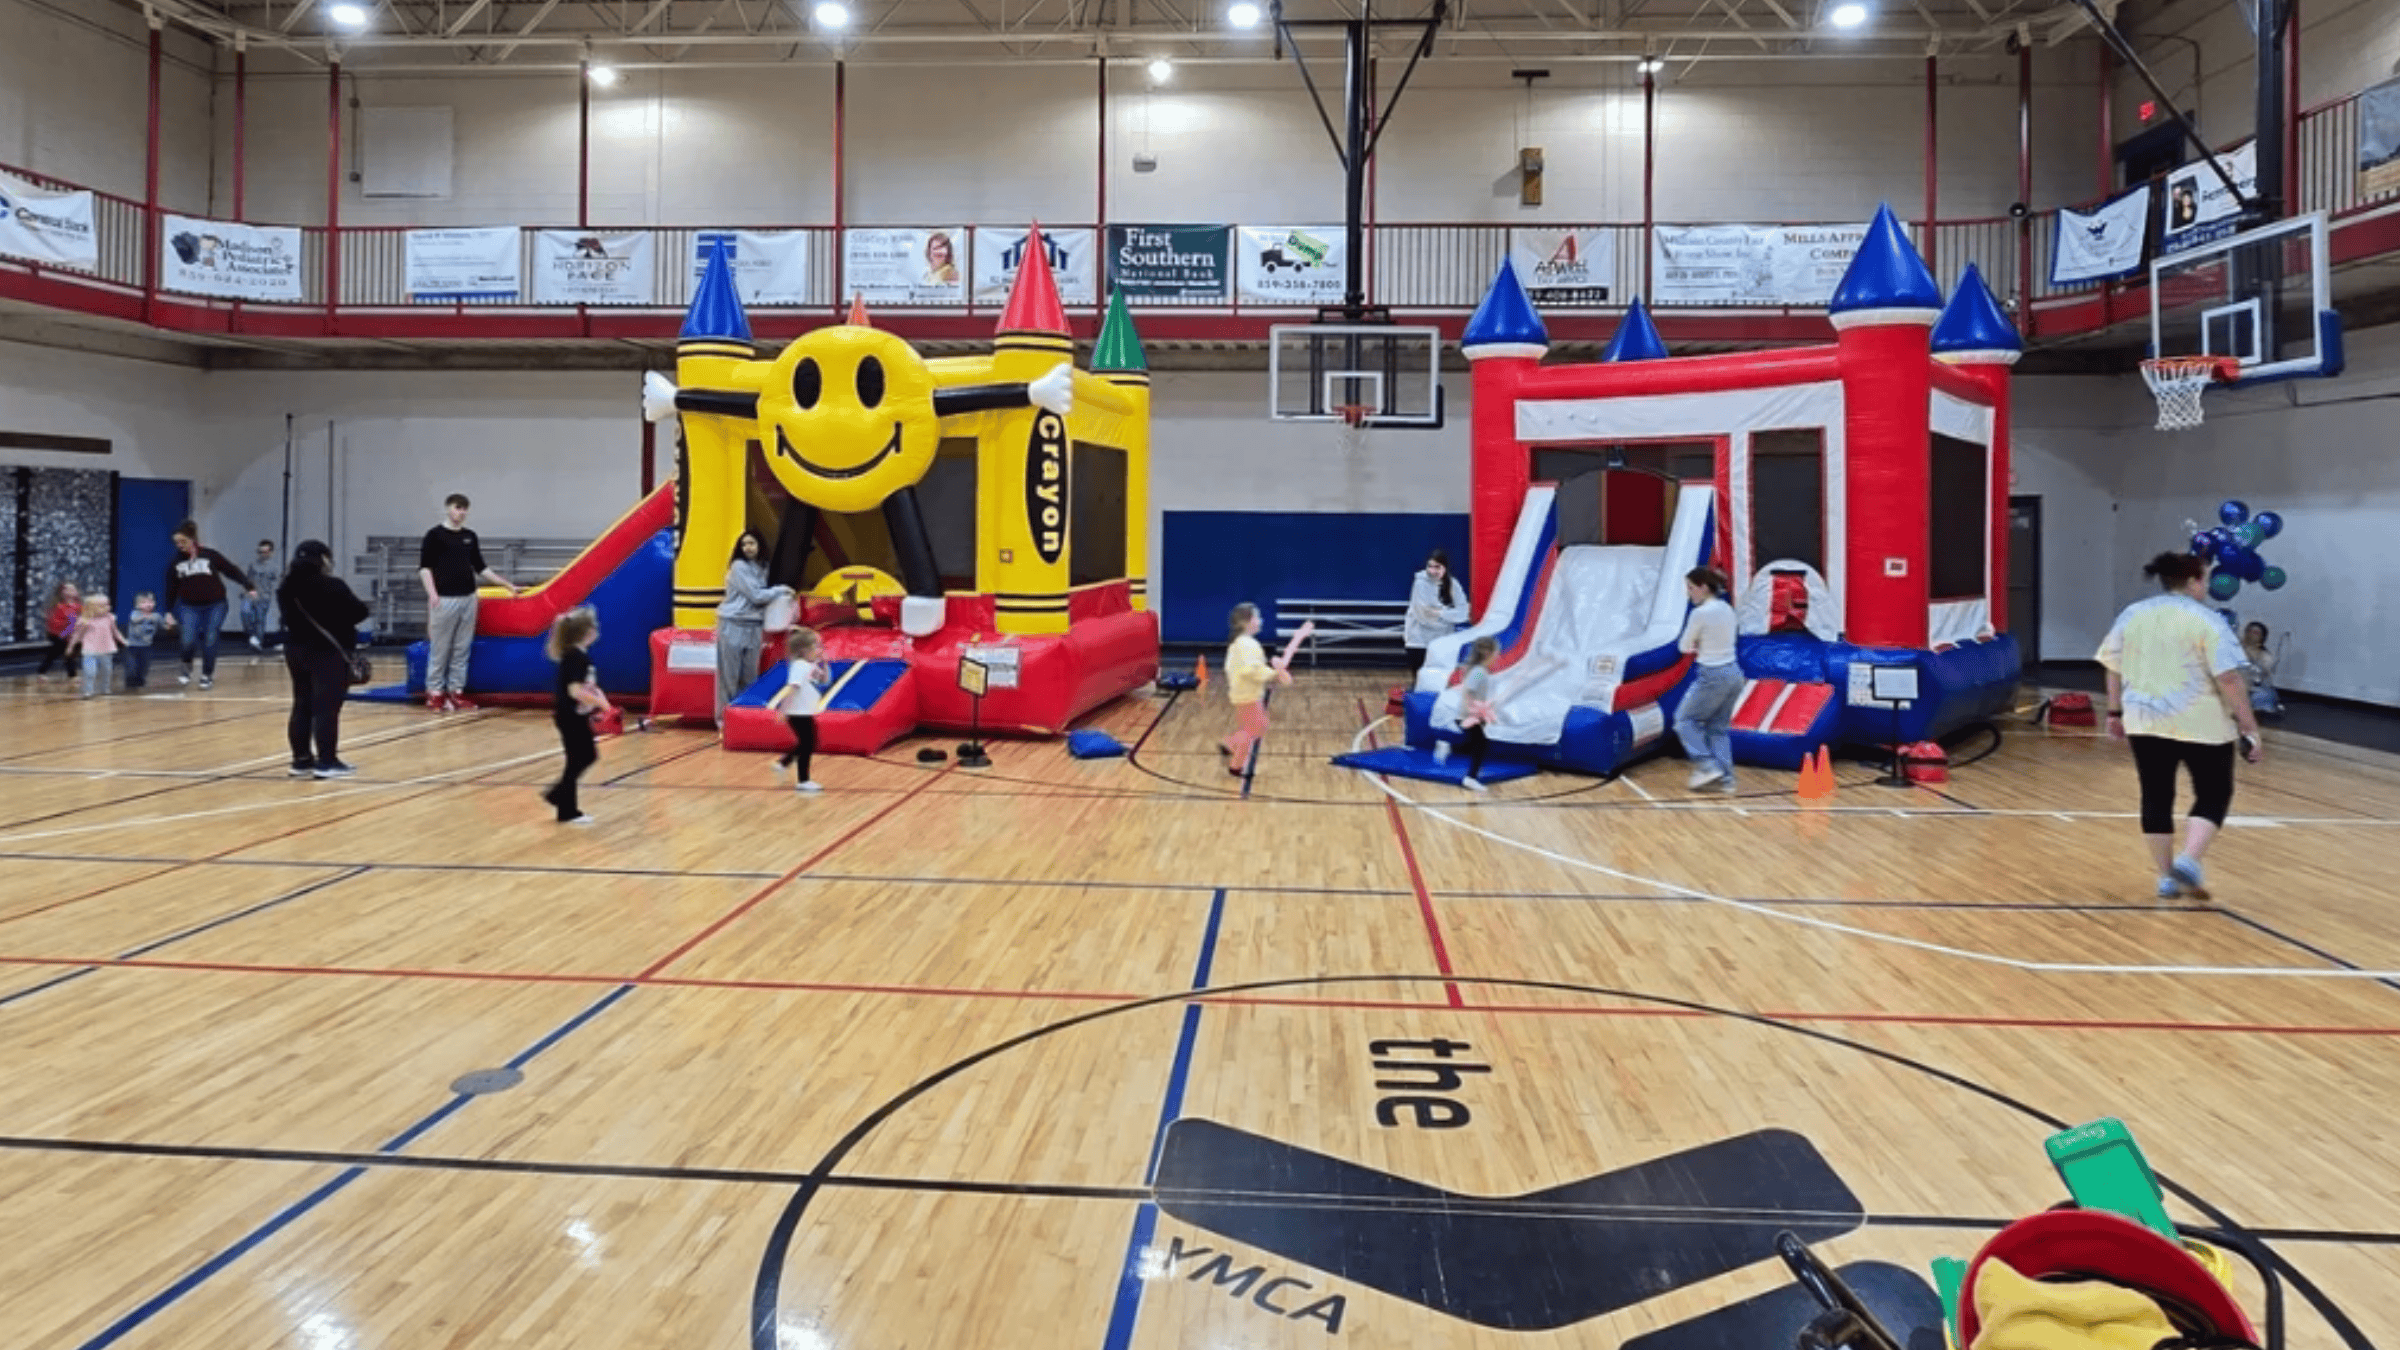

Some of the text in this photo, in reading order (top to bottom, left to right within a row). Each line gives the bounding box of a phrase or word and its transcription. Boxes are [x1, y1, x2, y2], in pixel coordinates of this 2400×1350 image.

[221, 239, 272, 254] Madison
[1126, 227, 1172, 248] First
[223, 250, 281, 266] Pediatric
[1120, 246, 1216, 267] Southern
[553, 260, 631, 272] HORIZON
[1120, 268, 1215, 279] National Bank
[566, 271, 615, 281] PACE
[1036, 415, 1062, 552] Crayon
[1369, 1038, 1492, 1128] the
[1163, 1235, 1347, 1335] YMCA
